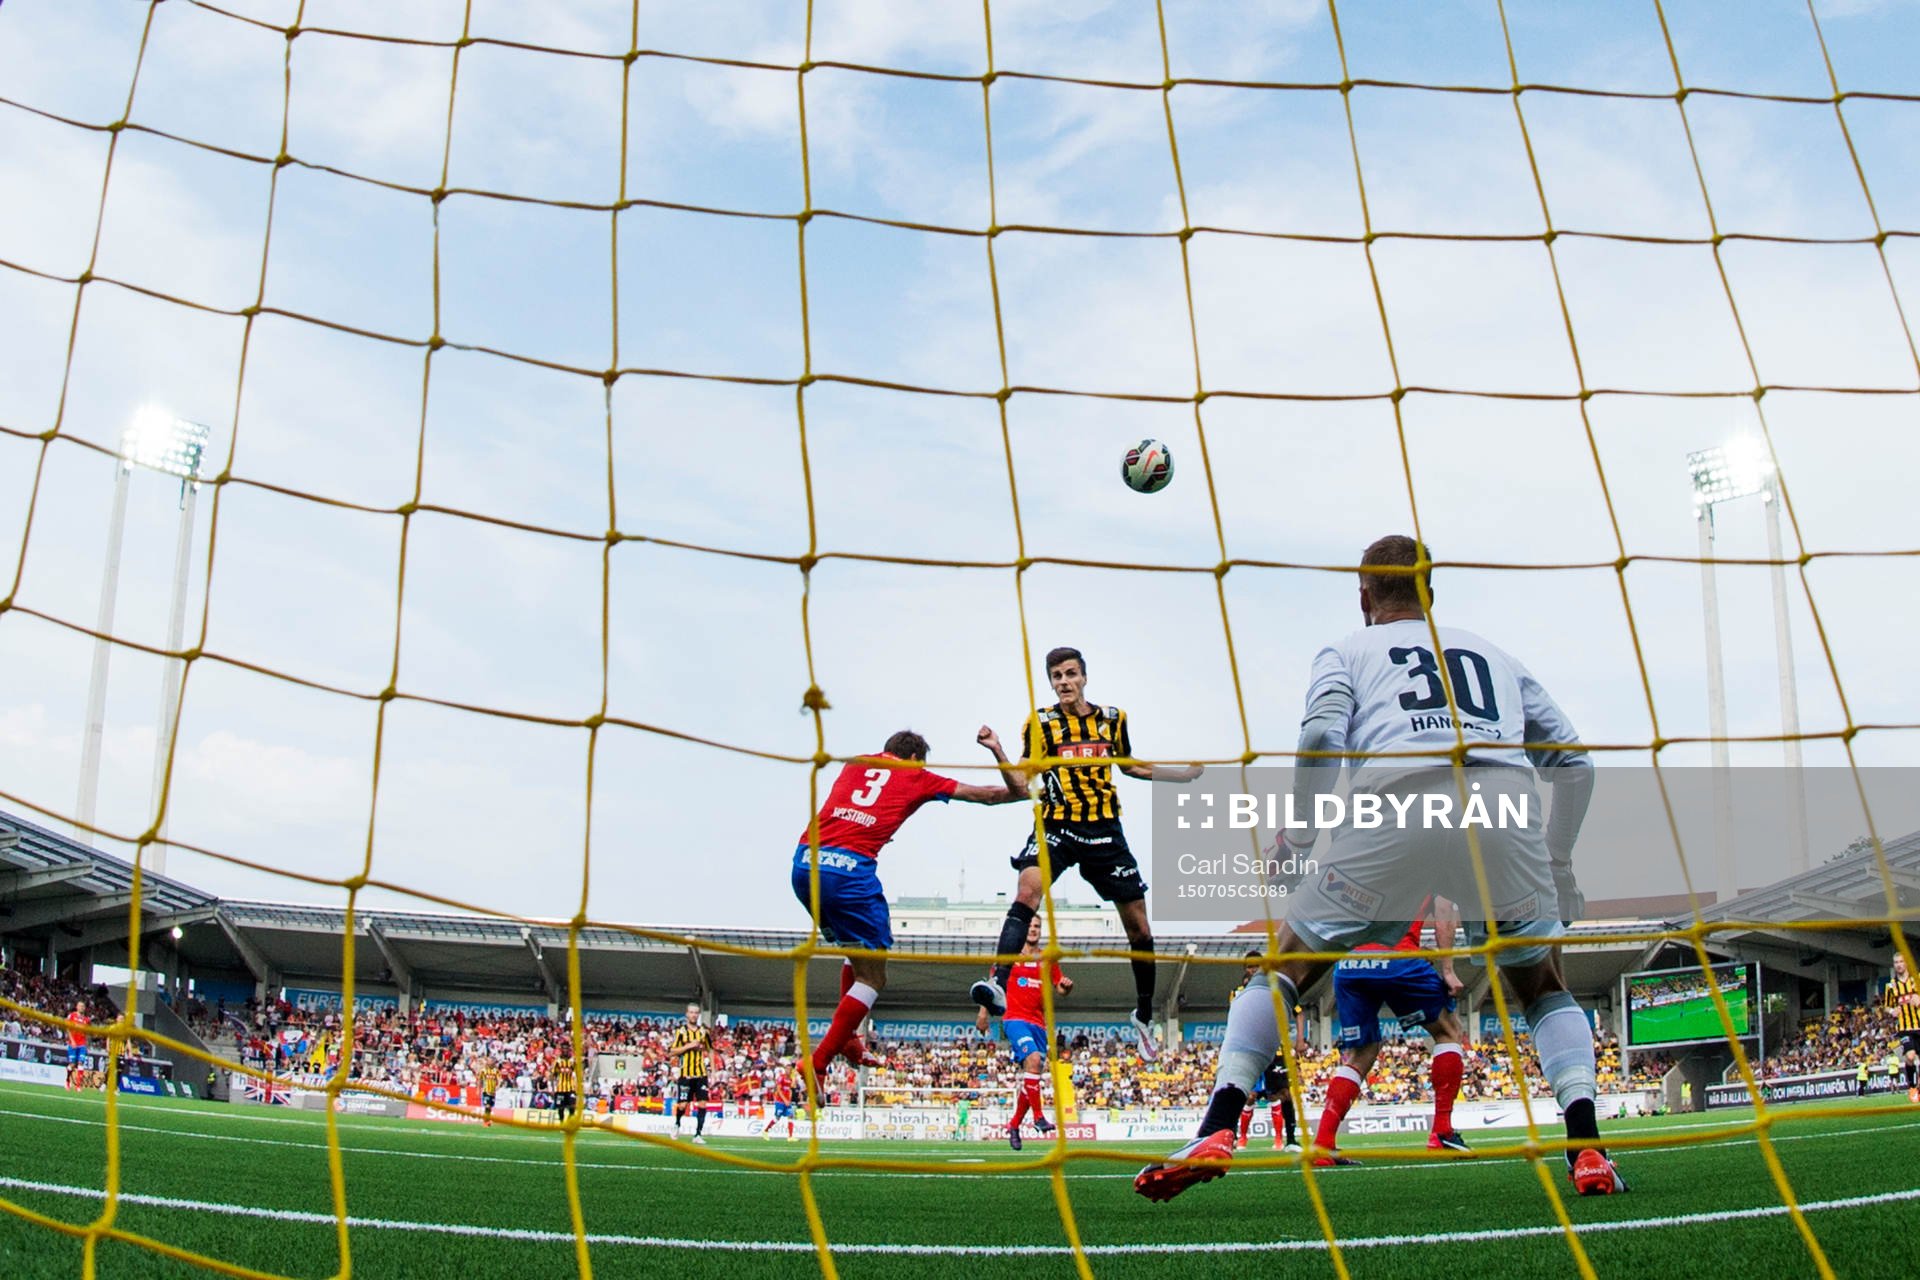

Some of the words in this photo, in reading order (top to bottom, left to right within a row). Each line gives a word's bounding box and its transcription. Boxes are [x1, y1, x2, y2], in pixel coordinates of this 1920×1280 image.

[1389, 646, 1500, 721] 30
[851, 768, 891, 807] 3
[802, 854, 857, 872] KAFT
[1338, 959, 1390, 970] KRAFT
[297, 992, 397, 1014] EHREBORG
[946, 1112, 989, 1125] hab
[1347, 1116, 1429, 1135] stadium
